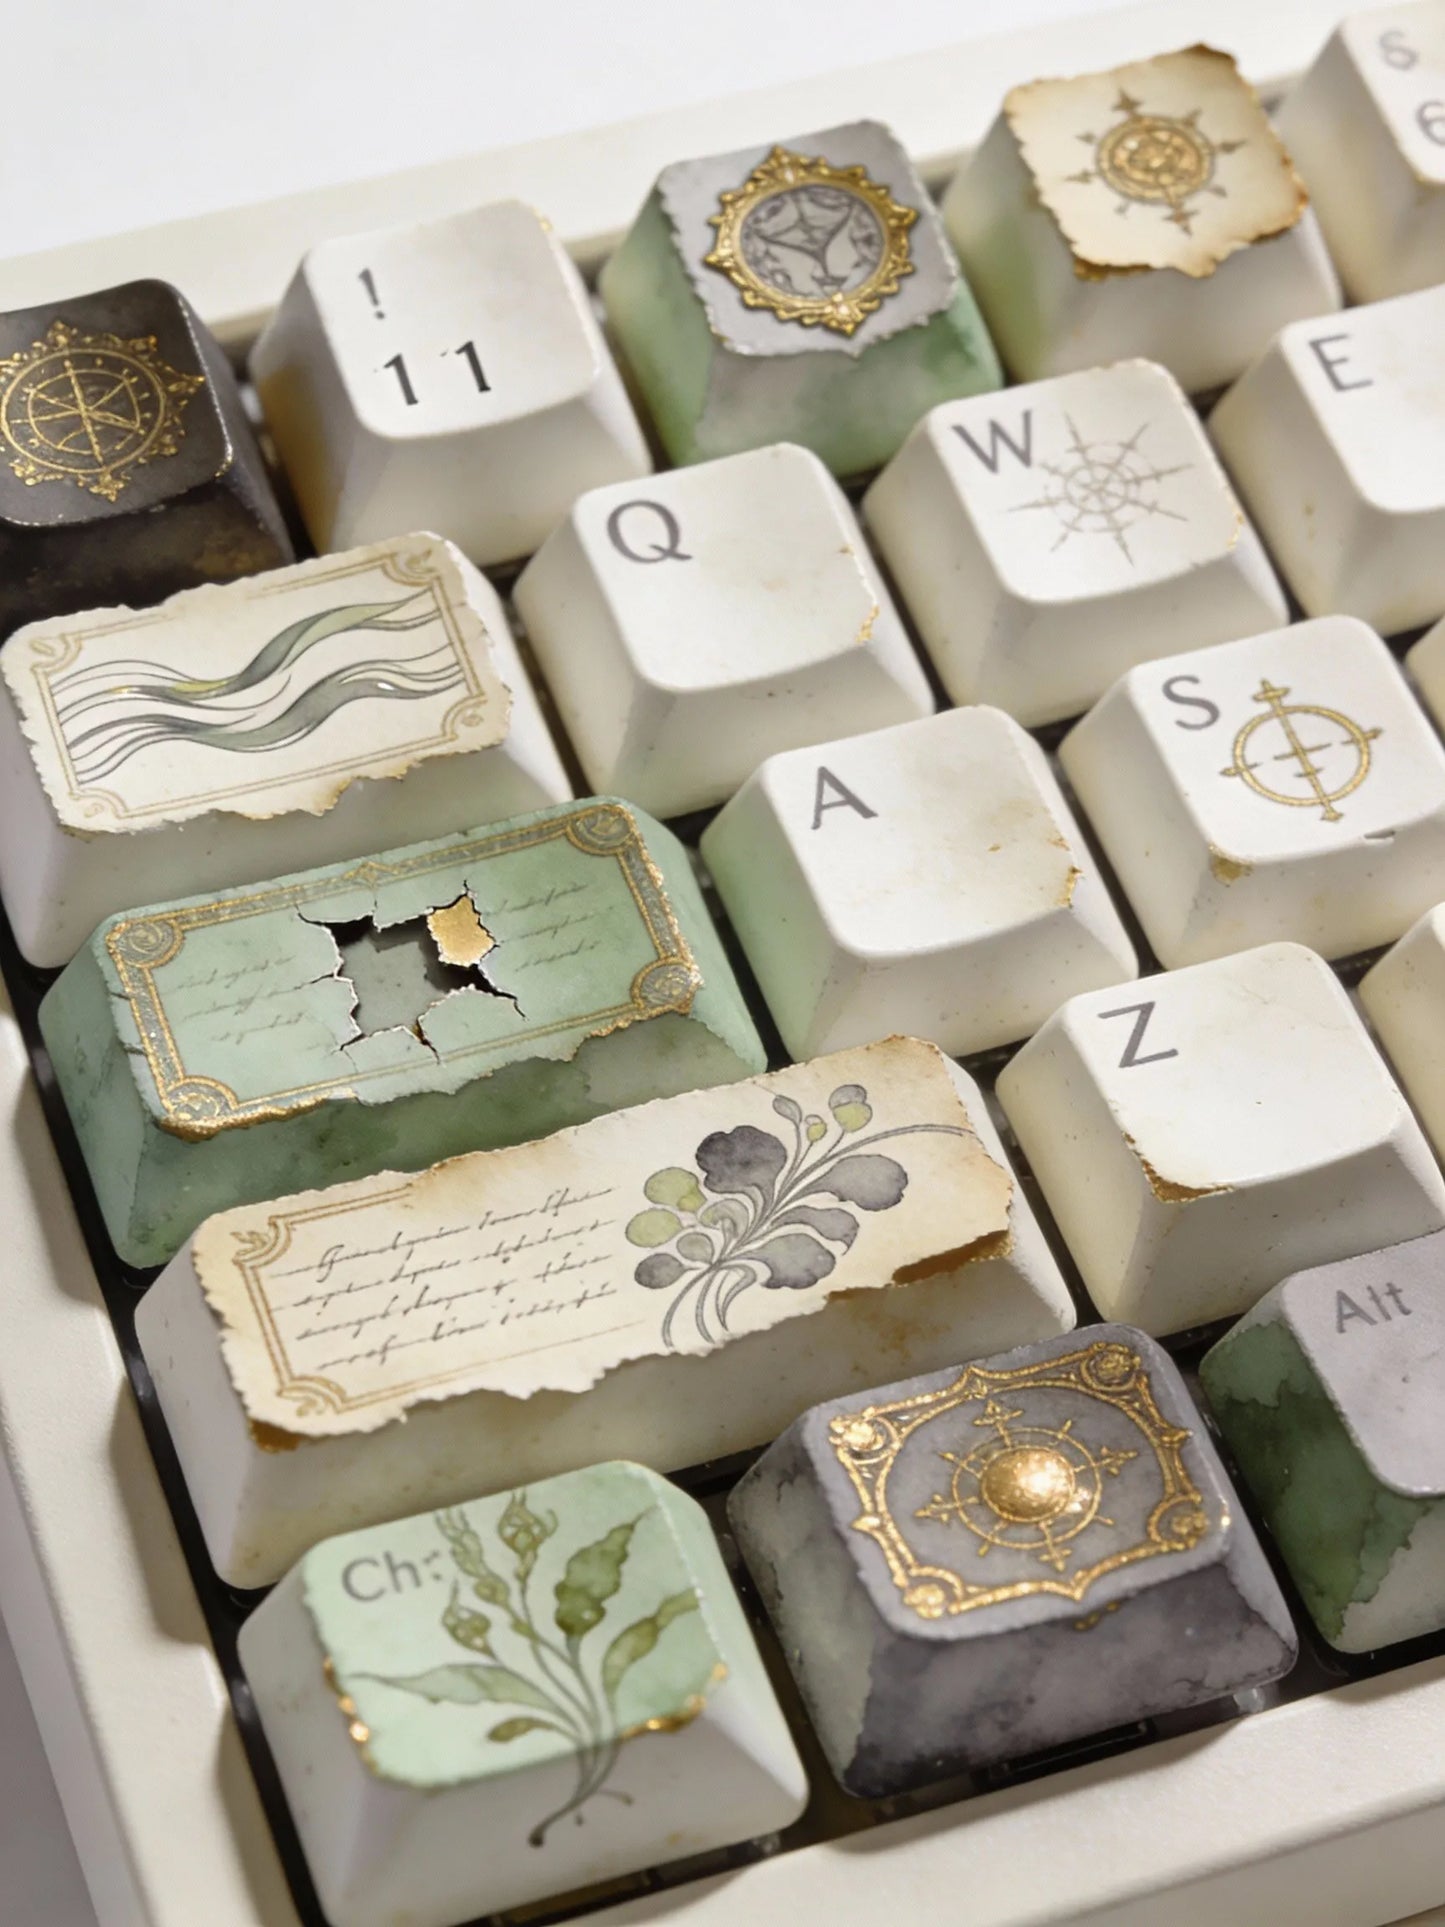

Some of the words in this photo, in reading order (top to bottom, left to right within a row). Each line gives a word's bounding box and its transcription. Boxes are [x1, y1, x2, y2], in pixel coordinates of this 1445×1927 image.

[358, 267, 386, 320] !
[1308, 333, 1375, 392] E
[951, 409, 1032, 474] W
[606, 499, 693, 564] Q
[1161, 675, 1221, 730] S
[811, 765, 879, 830] A
[1097, 1000, 1179, 1068] Z
[1336, 1281, 1413, 1334] Alt
